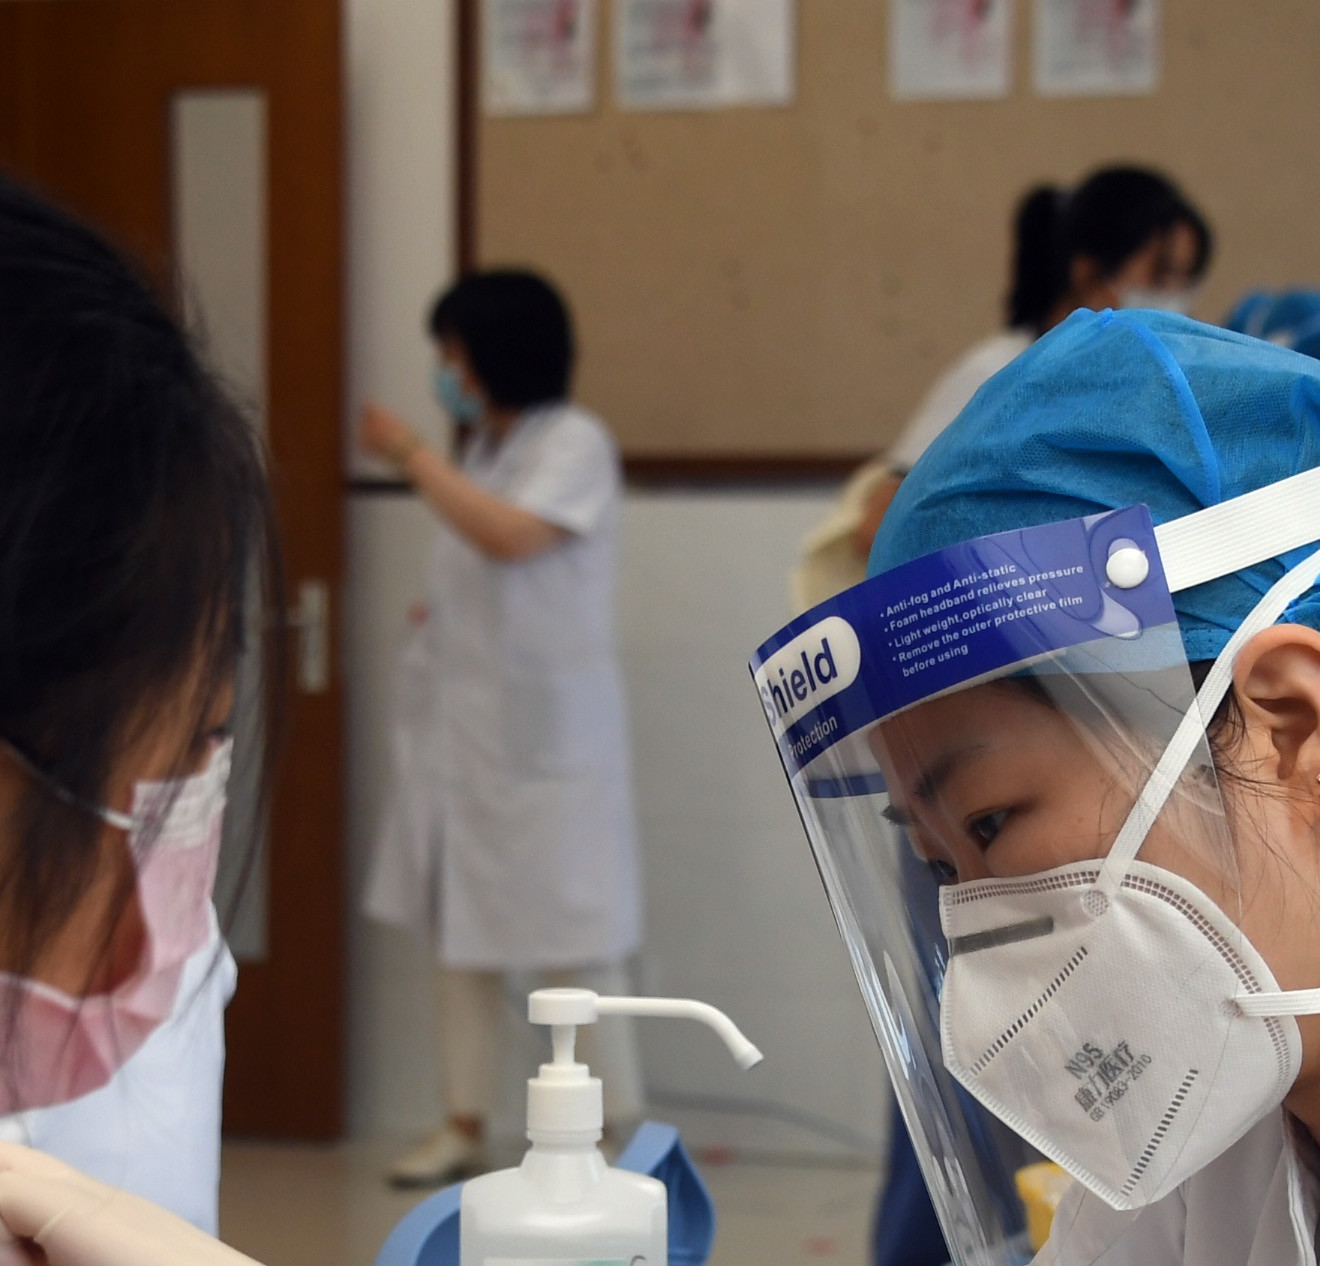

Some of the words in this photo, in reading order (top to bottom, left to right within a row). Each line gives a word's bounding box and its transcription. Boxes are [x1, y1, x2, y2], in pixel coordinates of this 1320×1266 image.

[886, 592, 929, 617] Anti-fog
[930, 582, 952, 598] and
[953, 564, 1017, 590] Anti-static
[889, 613, 919, 632] Foam
[919, 589, 975, 618] headband
[977, 577, 1026, 597] relieves
[1028, 565, 1084, 585] pressure
[894, 629, 922, 648] Light
[1016, 588, 1047, 603] clear
[898, 639, 940, 662] Remove
[941, 631, 960, 645] the
[961, 619, 992, 637] outer
[994, 602, 1057, 628] protective
[1058, 595, 1083, 608] film
[902, 657, 936, 678] before
[937, 644, 969, 662] using
[787, 715, 838, 763] Protection
[1064, 1042, 1103, 1080] N95
[1089, 1106, 1105, 1122] GB
